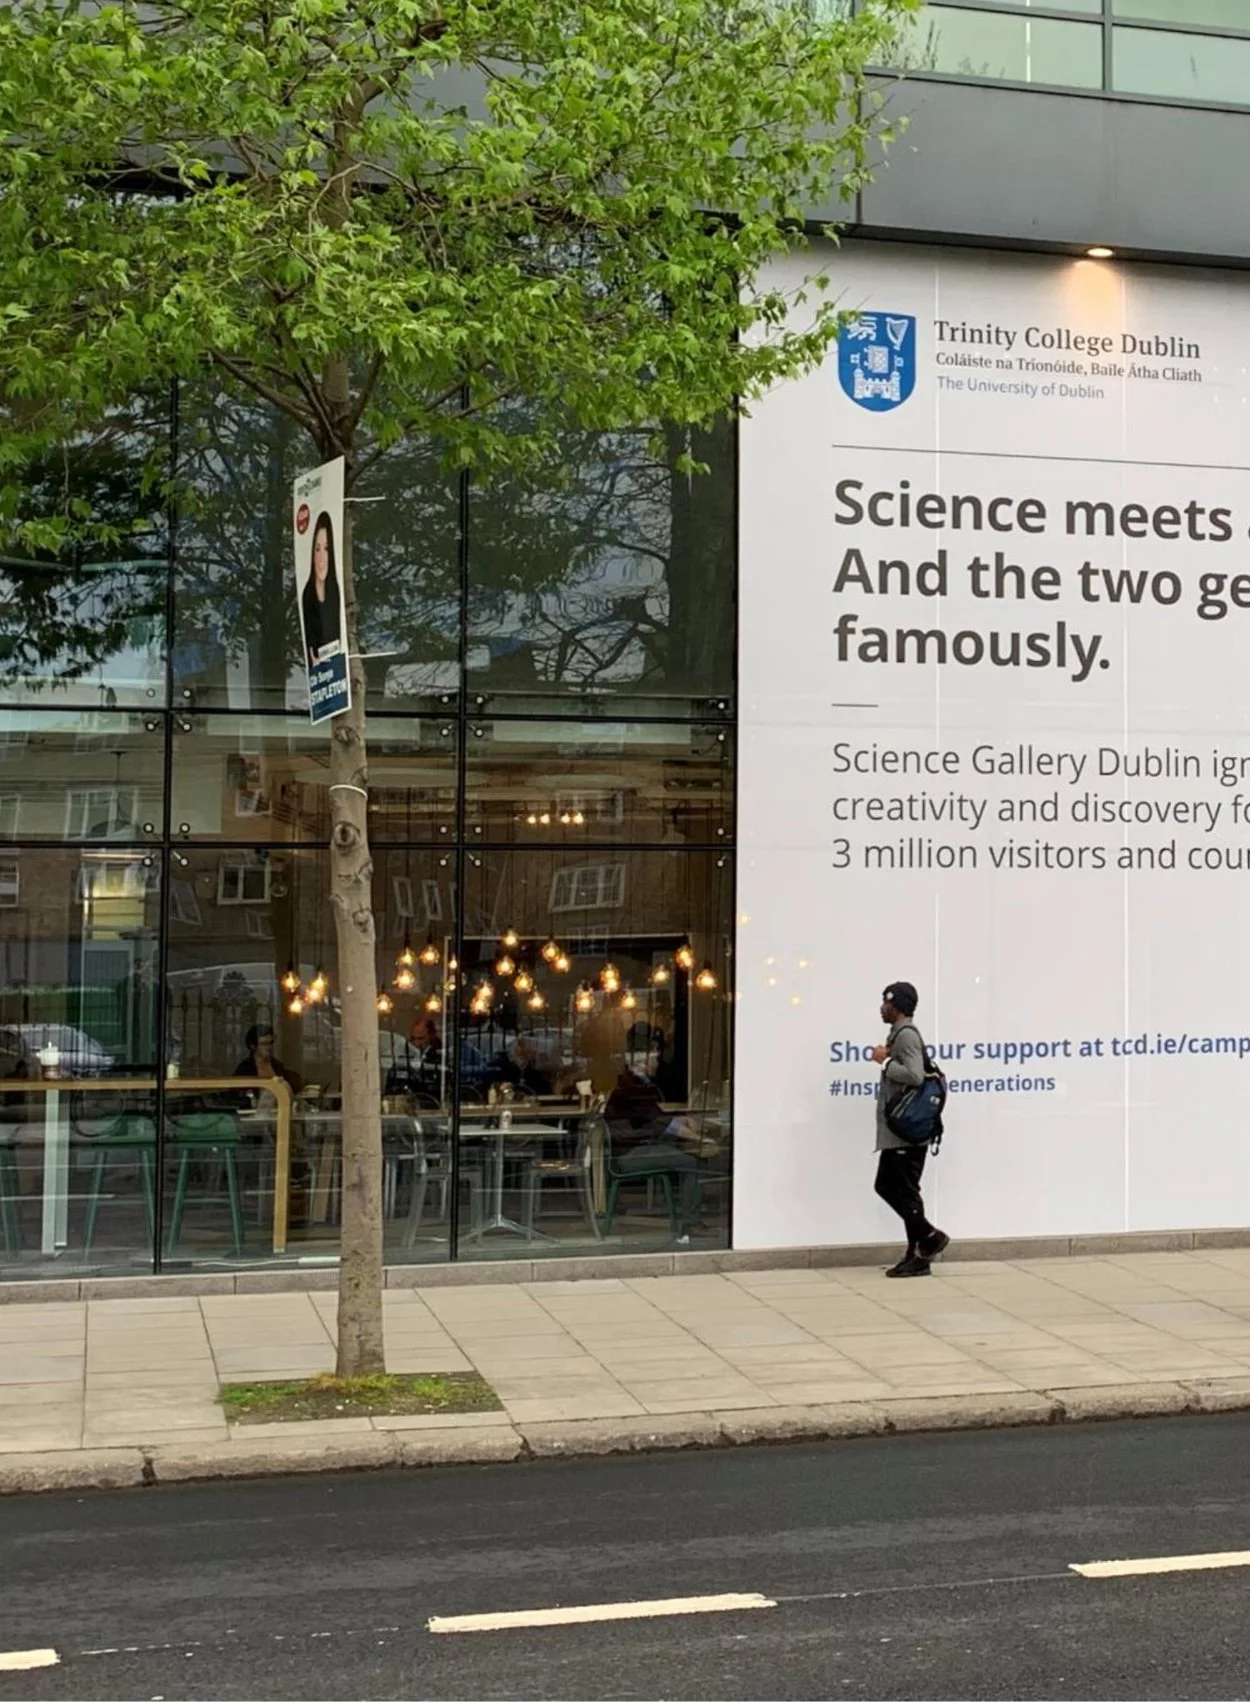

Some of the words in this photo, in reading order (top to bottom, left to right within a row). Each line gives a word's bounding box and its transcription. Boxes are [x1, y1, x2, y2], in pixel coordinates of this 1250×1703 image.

[933, 320, 1018, 351] Trinity
[1024, 327, 1113, 355] College
[1121, 333, 1200, 359] Dublin
[936, 352, 992, 369] Coláiste
[996, 359, 1013, 370] na
[1091, 362, 1125, 377] Baile
[1127, 362, 1159, 380] Átha
[1162, 367, 1202, 383] Cliath
[937, 376, 963, 390] The
[967, 377, 1037, 397] University
[1041, 382, 1055, 396] of
[1059, 384, 1104, 399] Dublin
[835, 479, 1046, 533] Science
[1066, 500, 1232, 542] meets
[832, 548, 947, 597] And
[967, 552, 1061, 601] the
[1077, 561, 1182, 605] two
[833, 614, 1110, 682] famously.
[833, 743, 960, 774] Science
[972, 744, 1087, 785] Gallery
[1099, 747, 1200, 778] Dublin
[833, 791, 987, 830] creativity
[998, 792, 1058, 822] and
[1071, 793, 1221, 832] discovery
[832, 838, 851, 868] 3
[865, 837, 977, 868] million
[988, 839, 1106, 869] visitors
[1117, 839, 1176, 869] and
[830, 1040, 874, 1062] Sho
[925, 1043, 966, 1060] our
[974, 1038, 1072, 1065] support
[1079, 1038, 1104, 1057] at
[830, 1074, 1056, 1098] #Inspenerations
